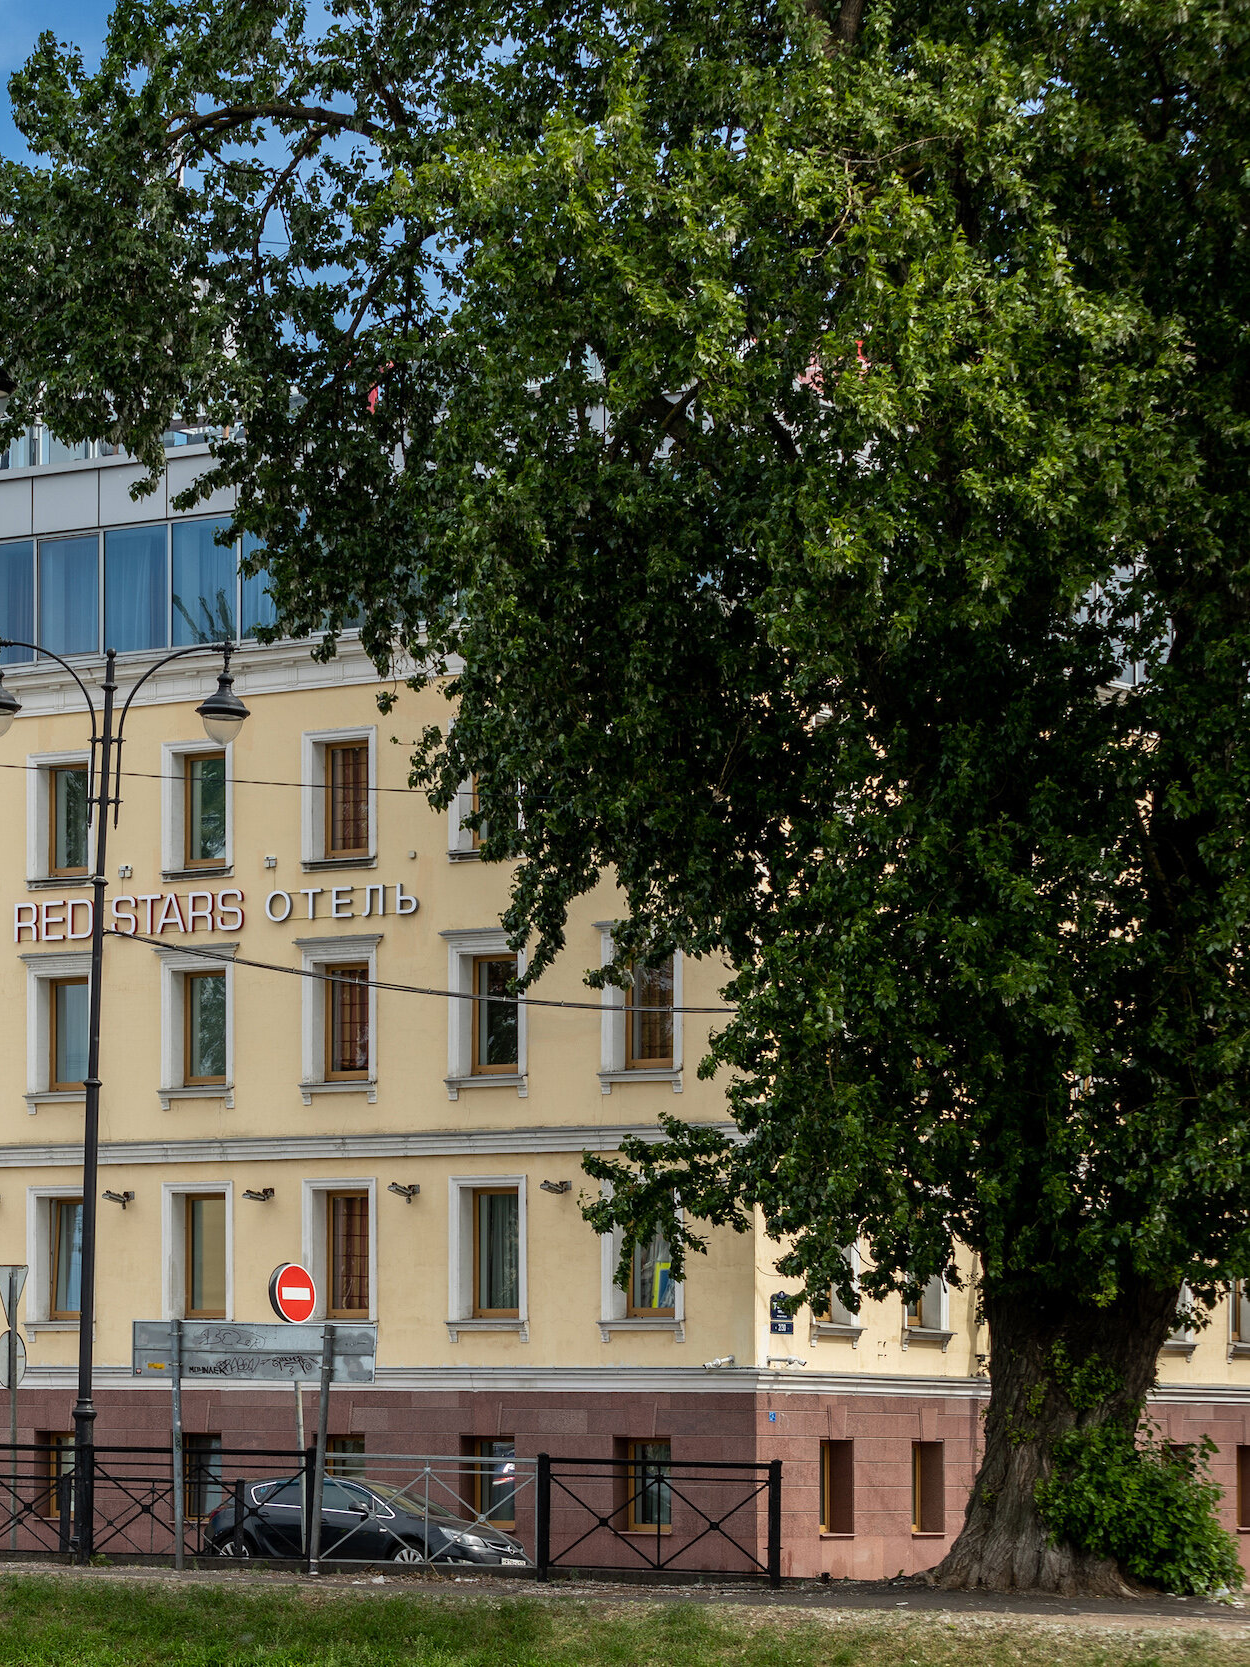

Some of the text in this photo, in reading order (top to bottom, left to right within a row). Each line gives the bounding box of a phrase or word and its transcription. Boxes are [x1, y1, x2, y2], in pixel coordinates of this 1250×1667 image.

[14, 899, 94, 943] RED
[110, 888, 244, 936] STARS
[264, 882, 420, 922] ОТЕЛЬ
